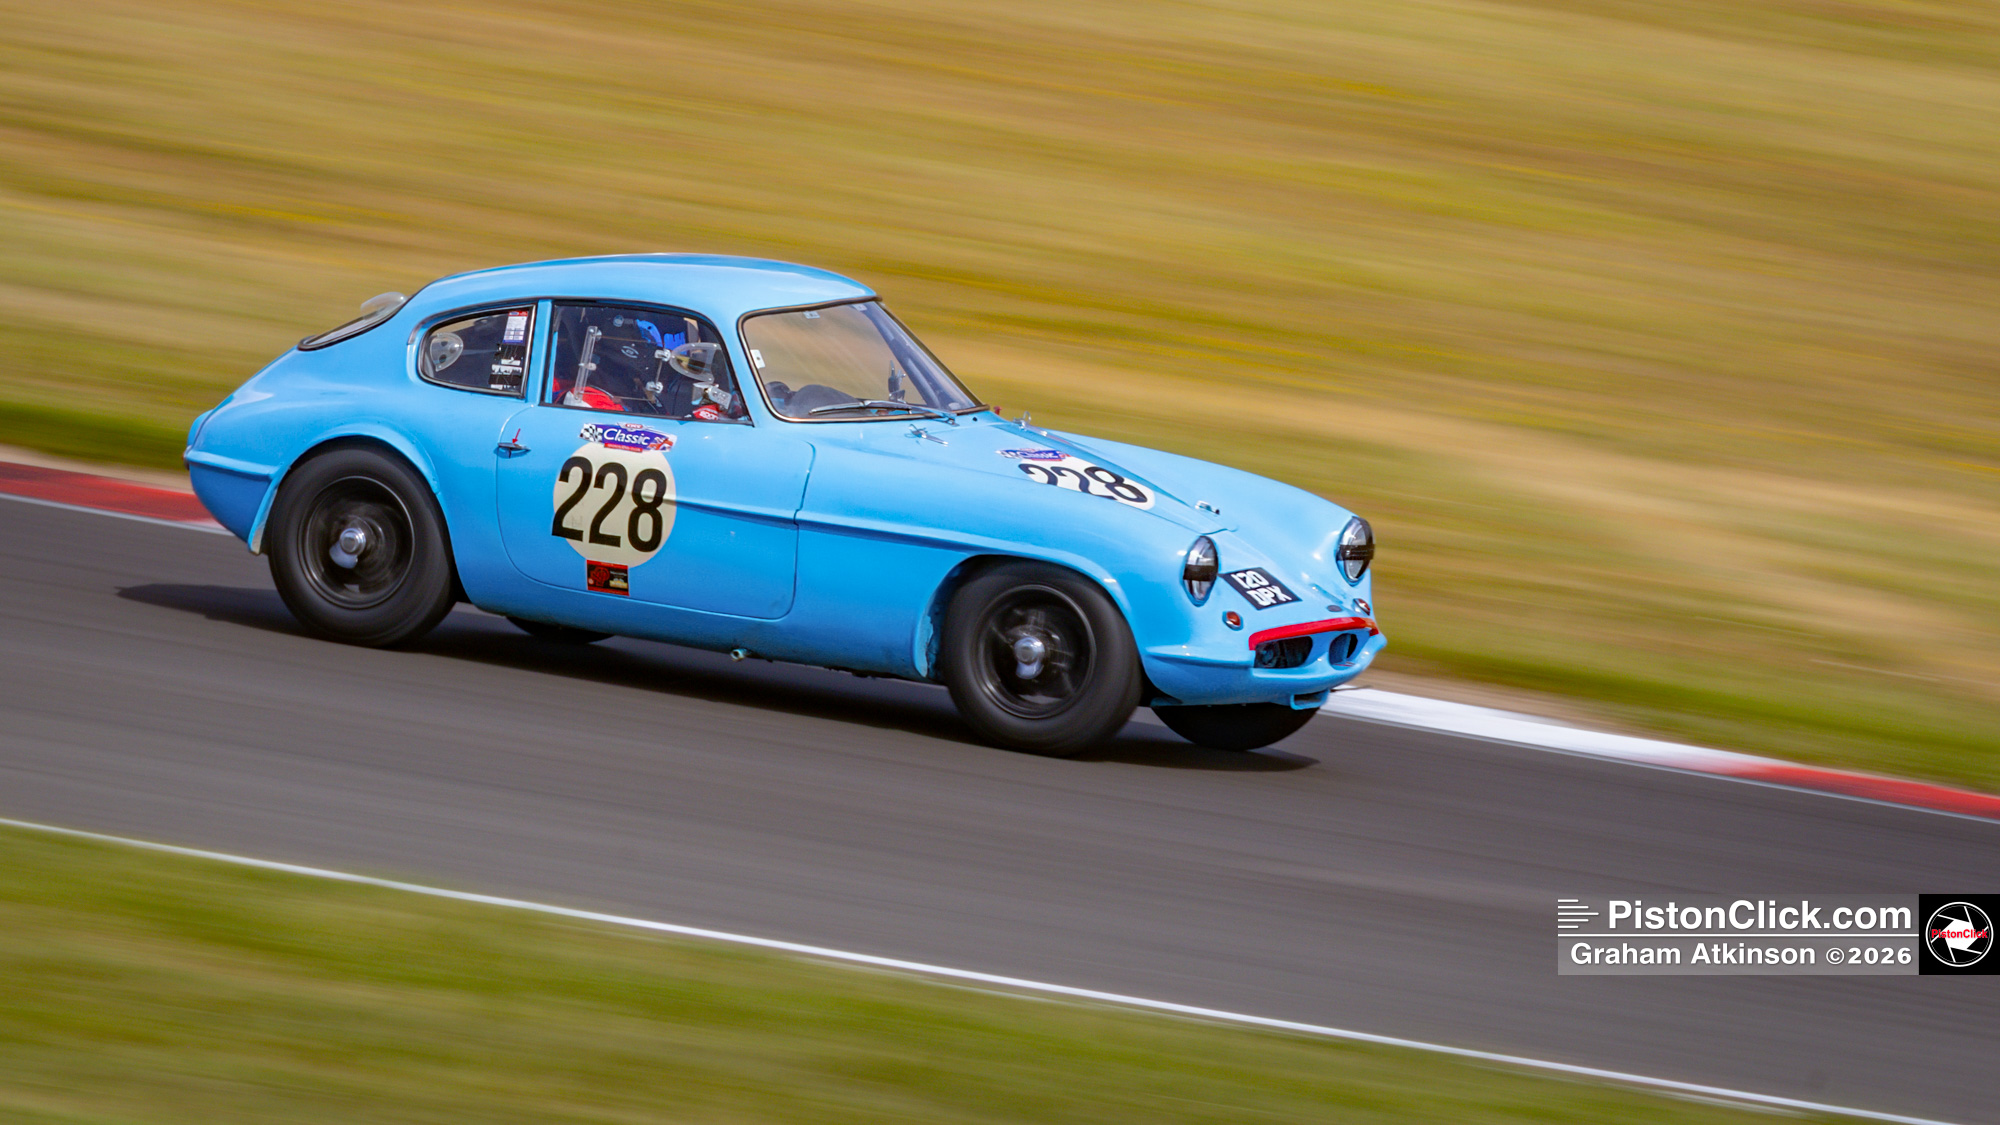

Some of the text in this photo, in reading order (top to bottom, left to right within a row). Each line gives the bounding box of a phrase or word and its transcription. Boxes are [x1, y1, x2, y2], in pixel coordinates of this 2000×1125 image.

[603, 428, 651, 446] Classic
[1018, 463, 1148, 503] 228
[551, 456, 667, 553] 228
[1230, 570, 1270, 589] 120
[1246, 585, 1292, 607] DPX
